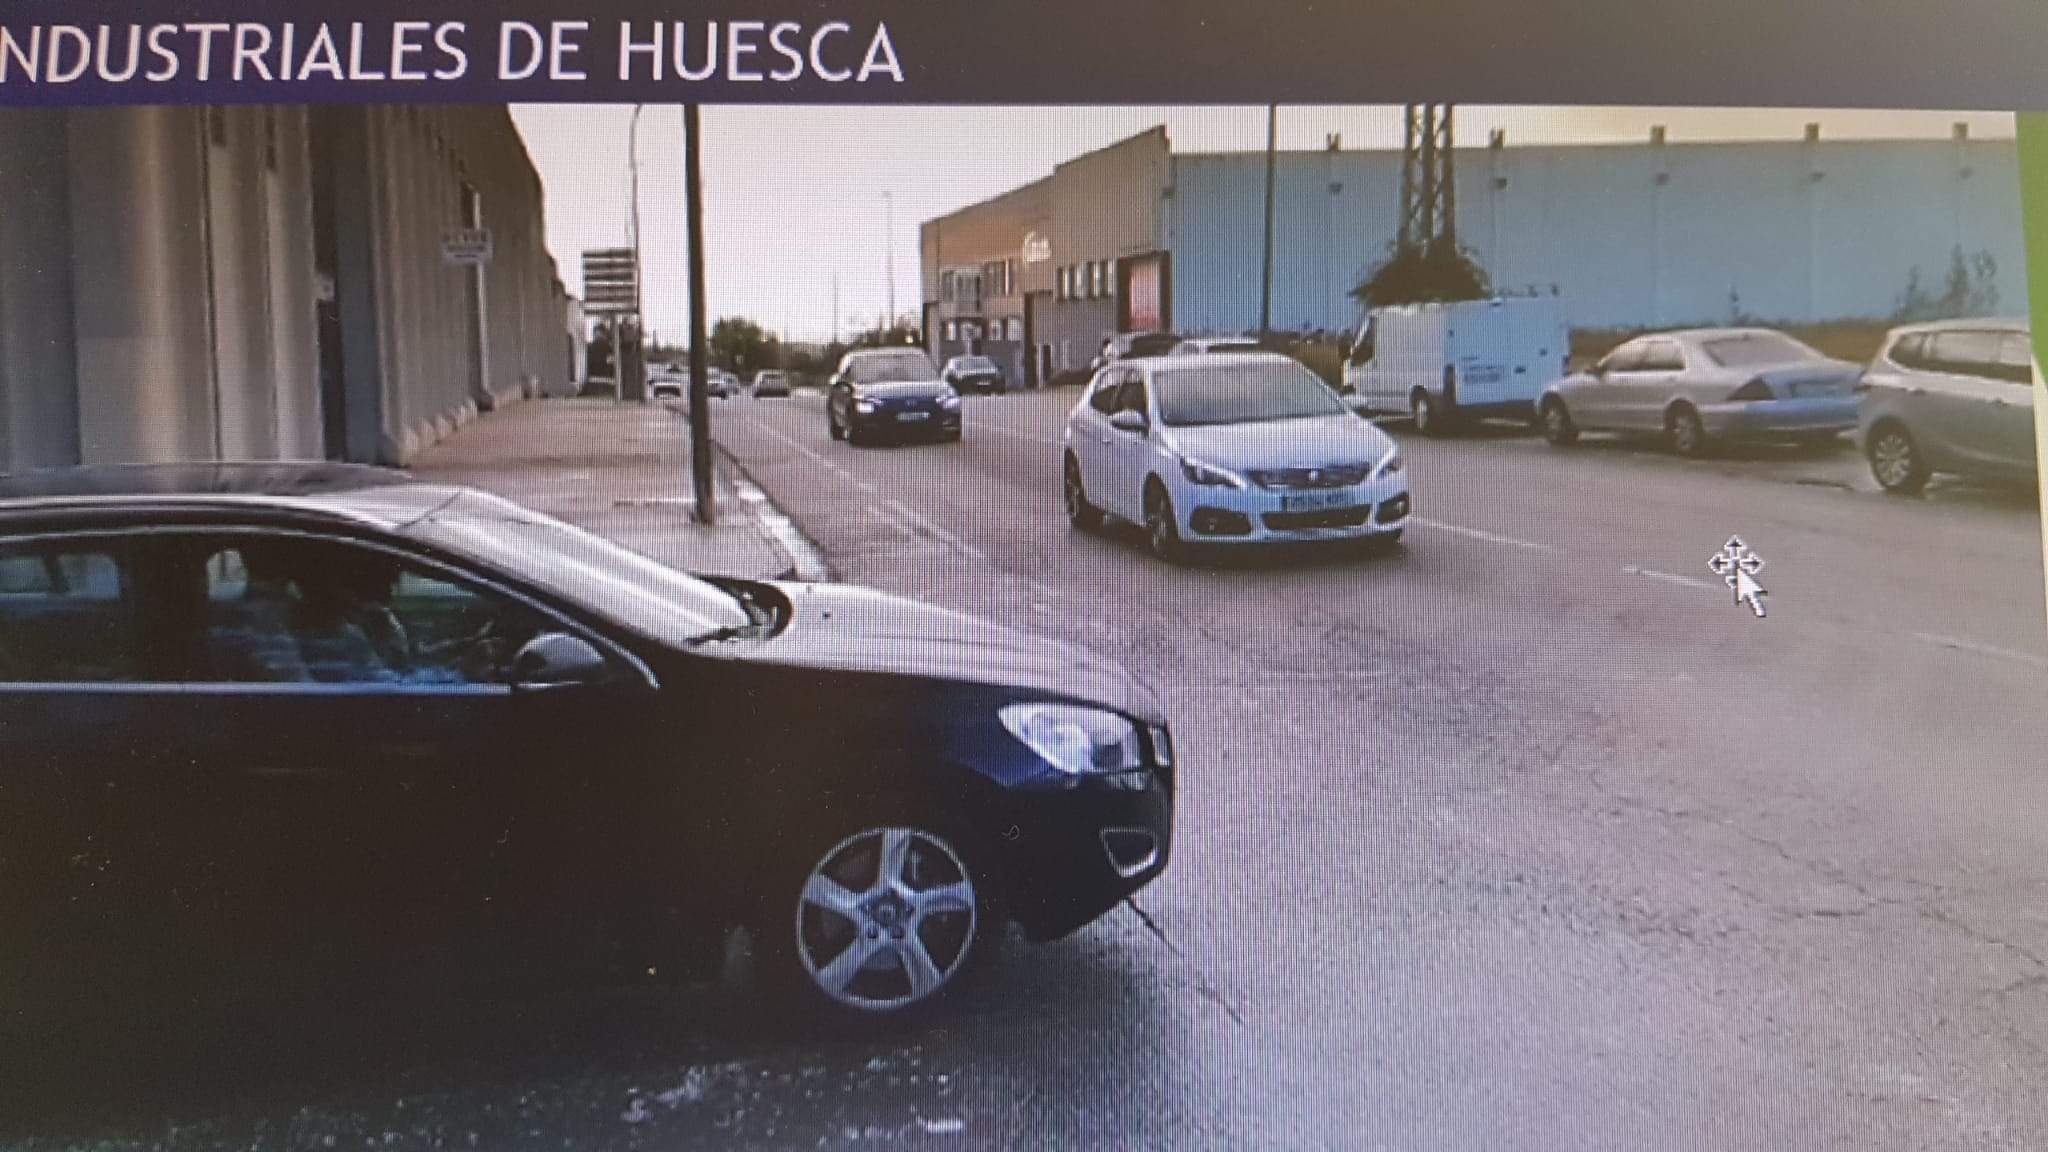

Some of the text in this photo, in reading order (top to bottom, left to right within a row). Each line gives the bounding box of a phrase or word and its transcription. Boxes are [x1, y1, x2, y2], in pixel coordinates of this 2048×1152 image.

[0, 21, 905, 83] NDUSTRIALES DE HUESCA
